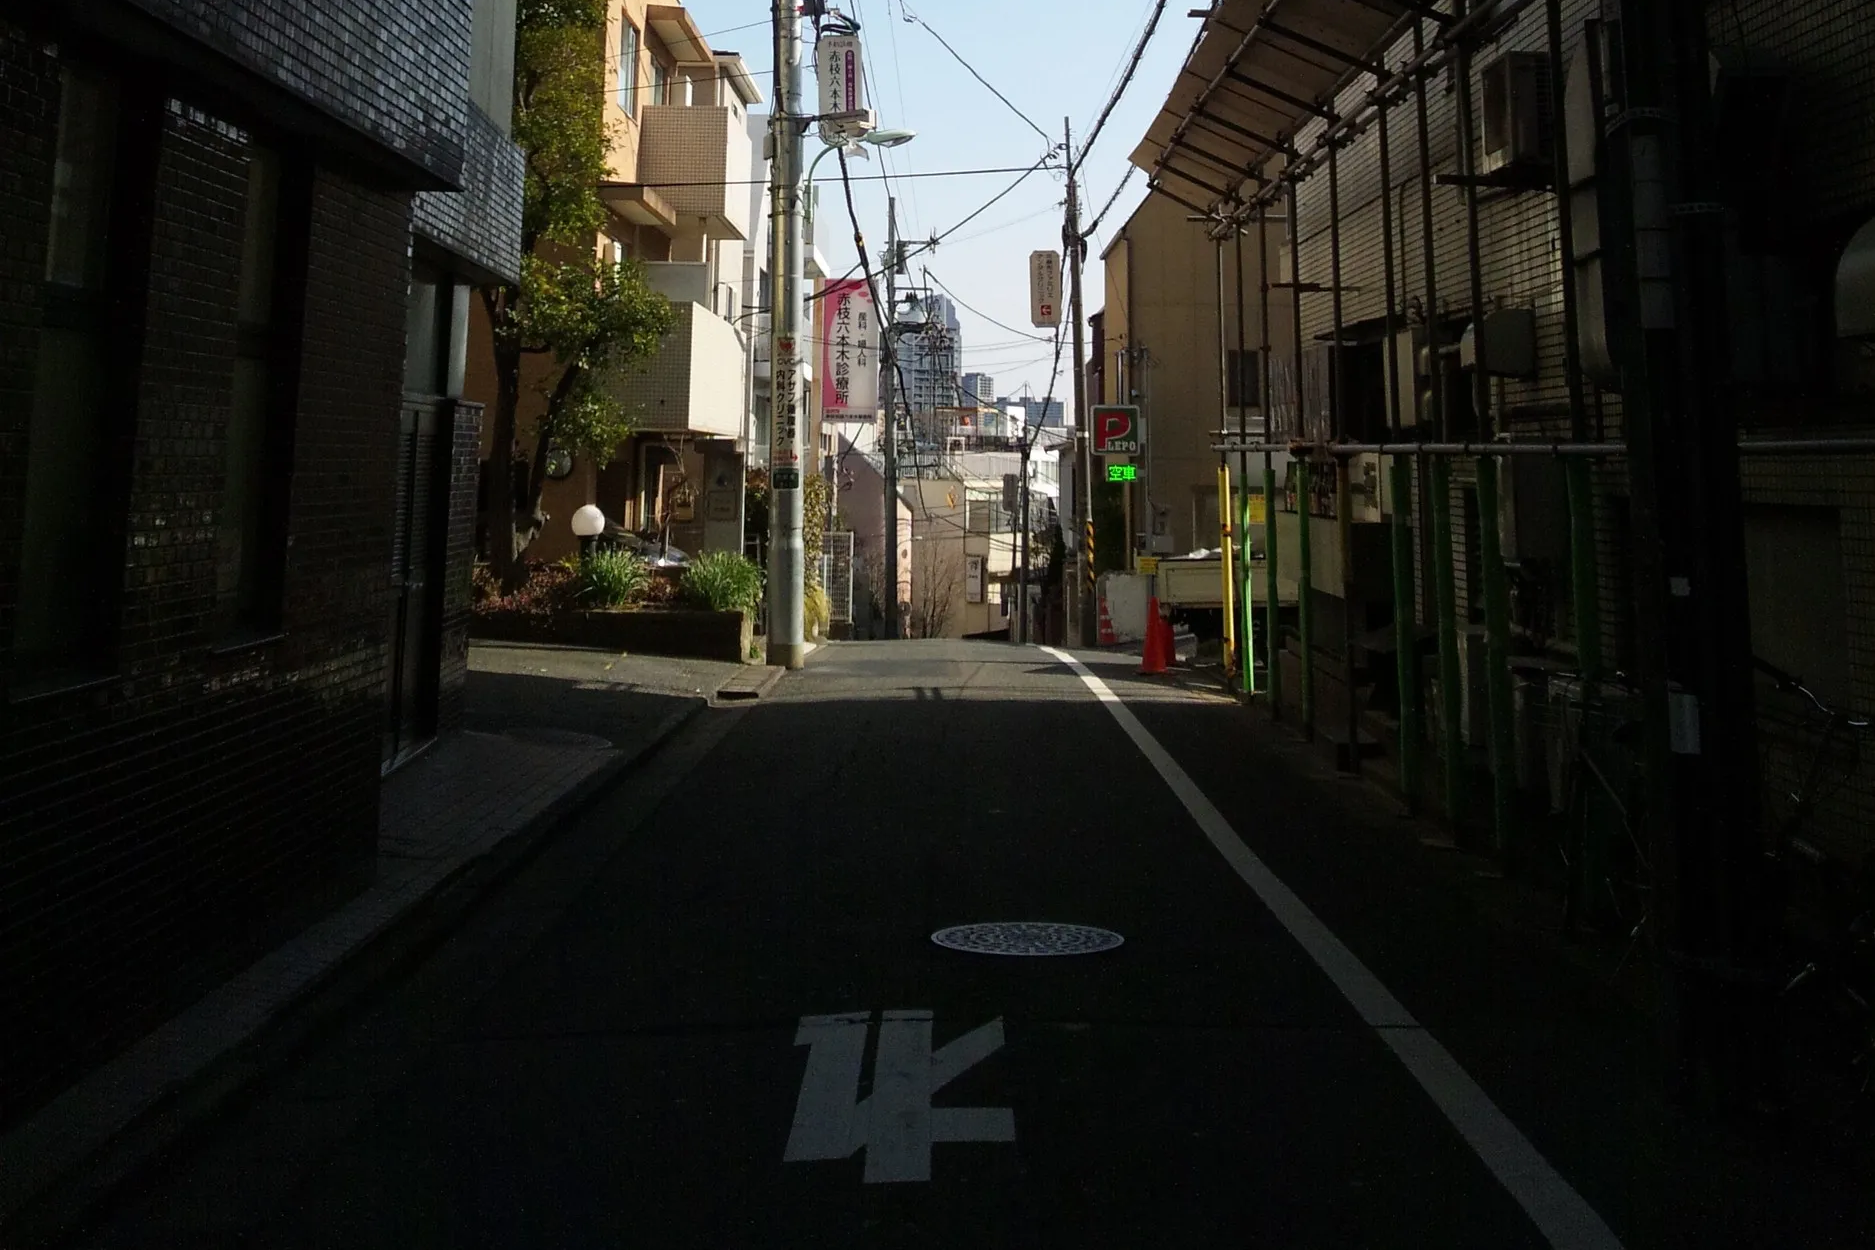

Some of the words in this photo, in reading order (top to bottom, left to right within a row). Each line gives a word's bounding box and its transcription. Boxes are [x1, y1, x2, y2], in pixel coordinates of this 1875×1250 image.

[836, 293, 851, 405] 赤枝六本木診療所
[1109, 465, 1136, 482] 空車
